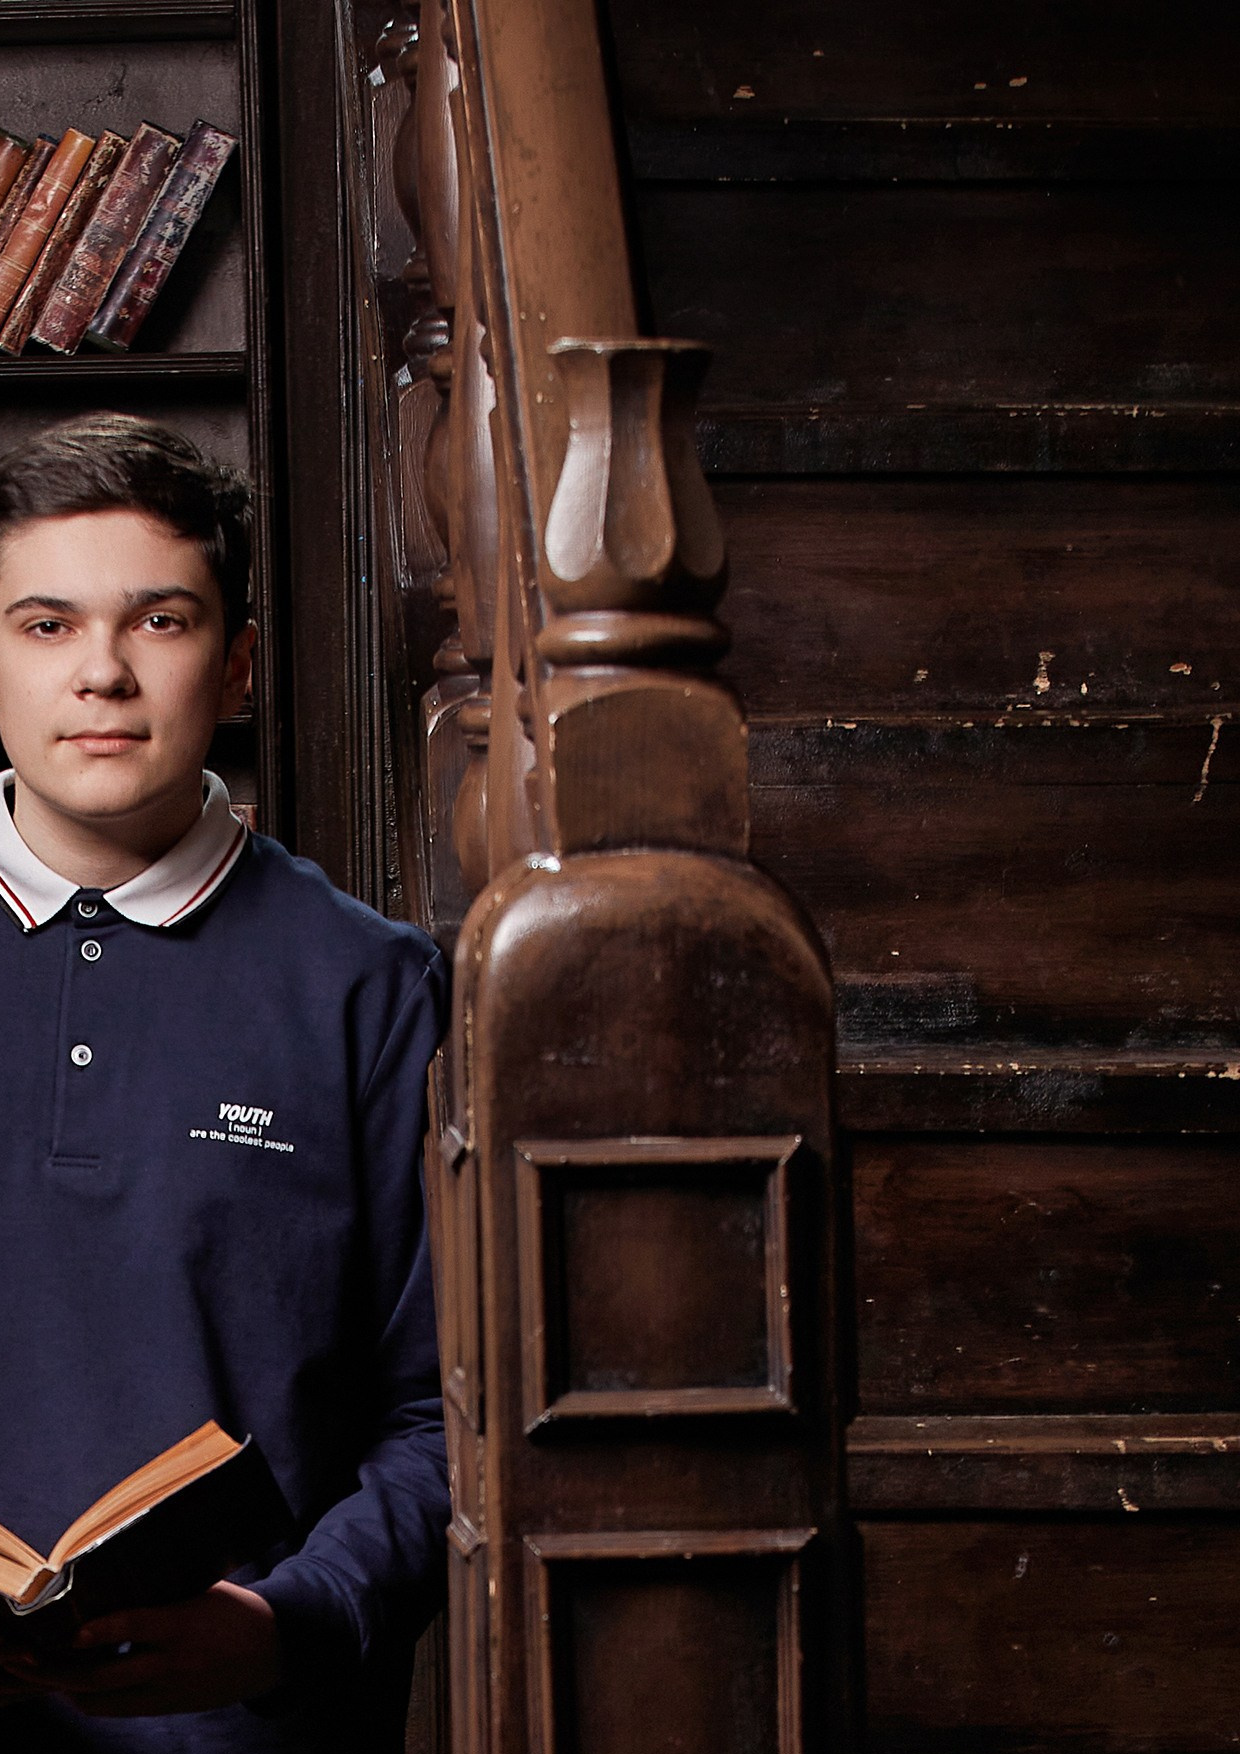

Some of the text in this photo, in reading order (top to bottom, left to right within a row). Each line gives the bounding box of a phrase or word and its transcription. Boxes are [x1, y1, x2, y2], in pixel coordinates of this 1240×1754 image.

[218, 1102, 273, 1127] YOUTH
[189, 1129, 295, 1153] are the coolest people
